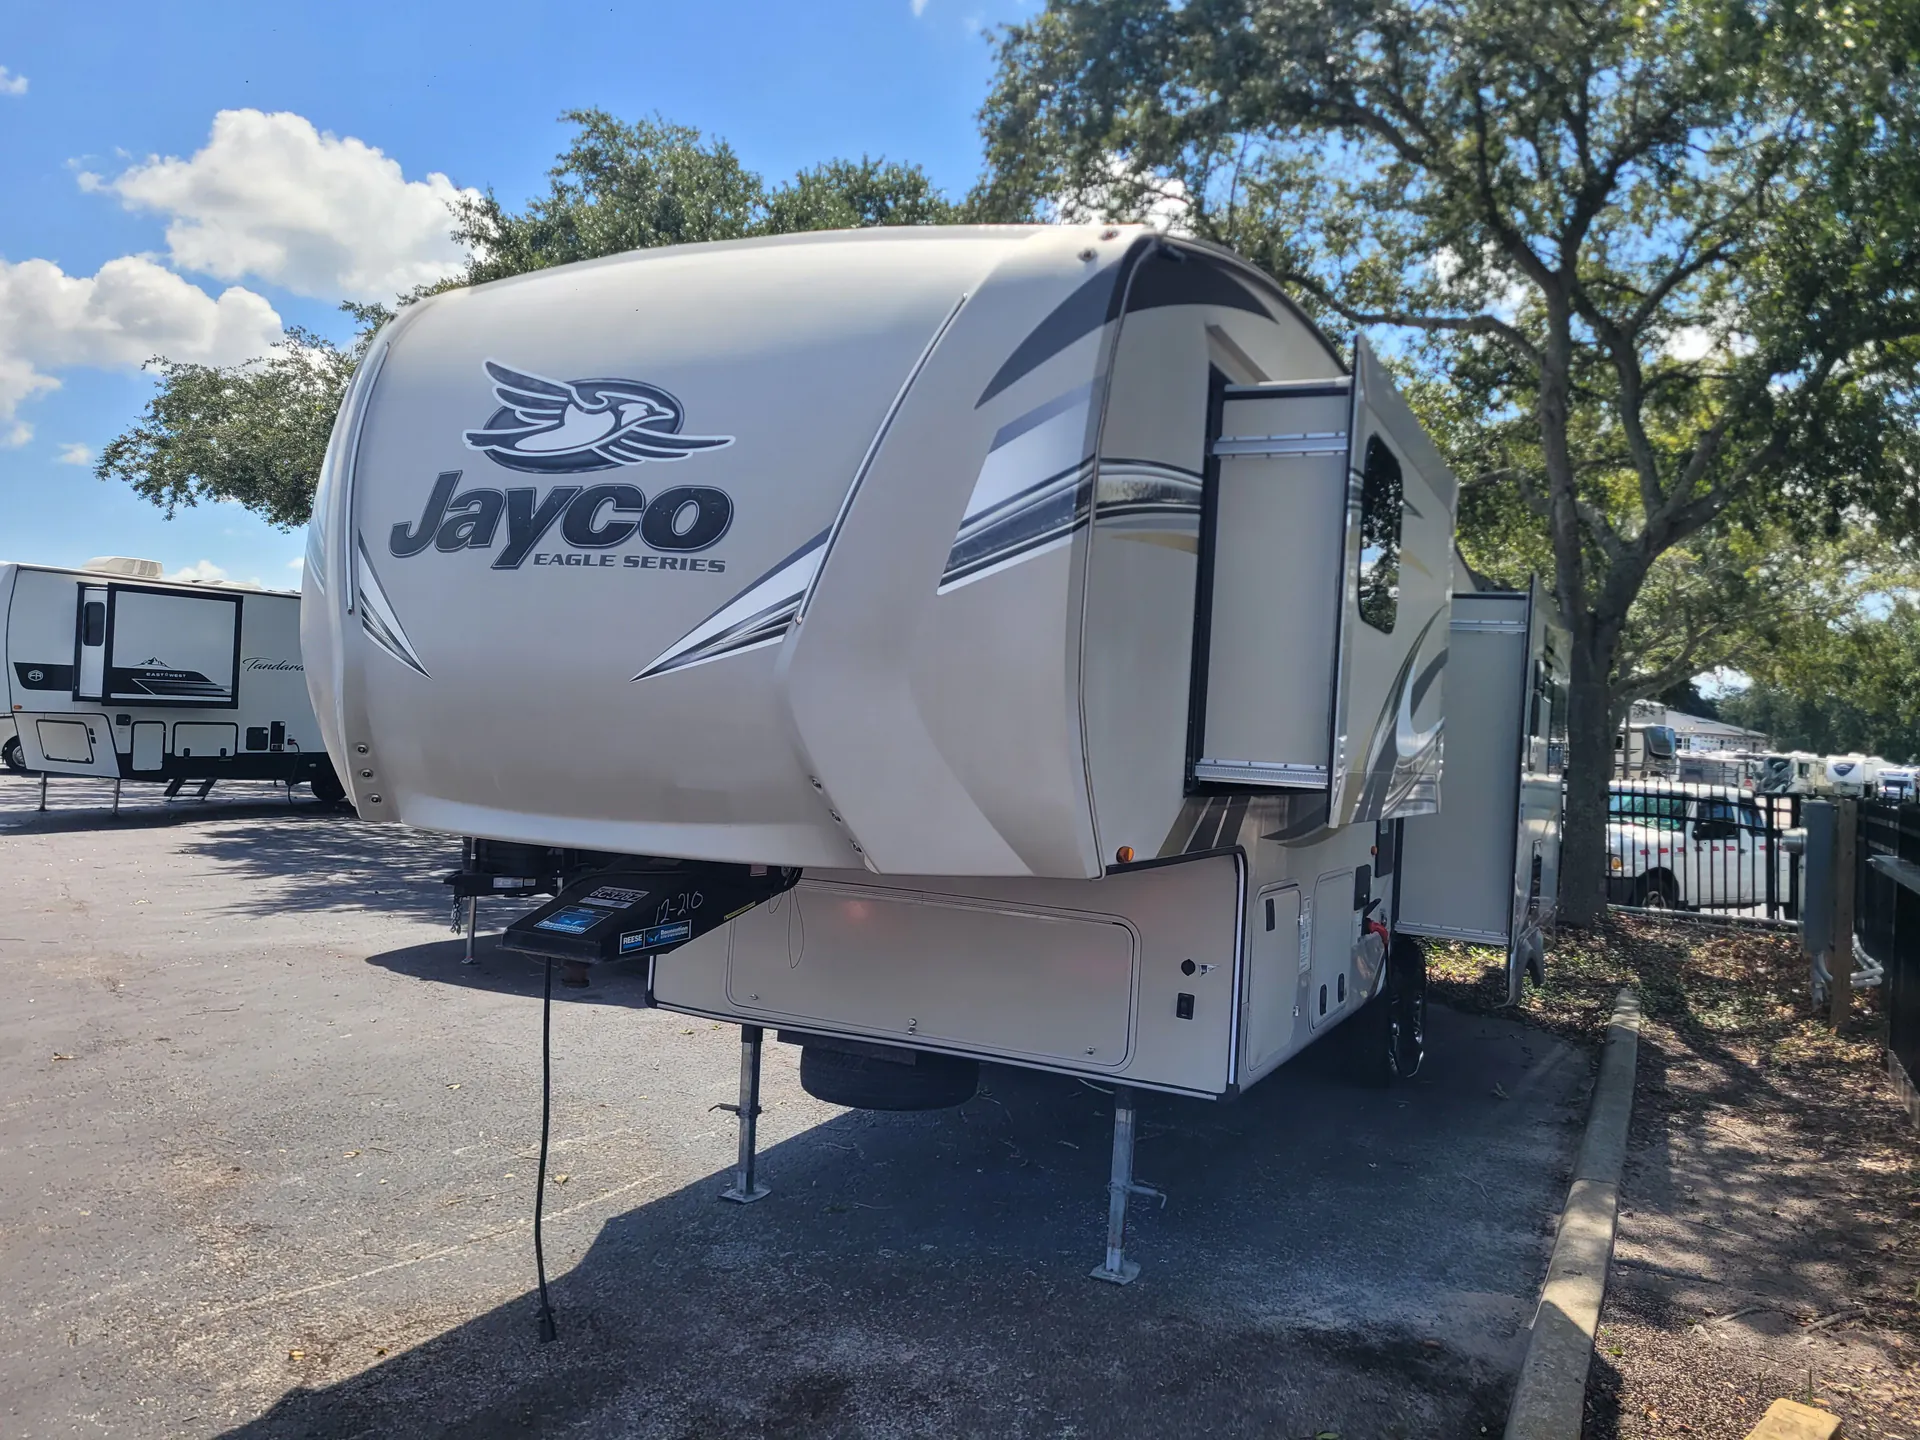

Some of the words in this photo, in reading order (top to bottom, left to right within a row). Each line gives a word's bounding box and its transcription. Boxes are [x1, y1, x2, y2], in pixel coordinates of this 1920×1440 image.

[388, 469, 735, 571] Jayco
[533, 553, 616, 568] EAGLE
[622, 555, 726, 573] SERIES
[242, 656, 305, 672] Tandara
[622, 933, 643, 945] REESE
